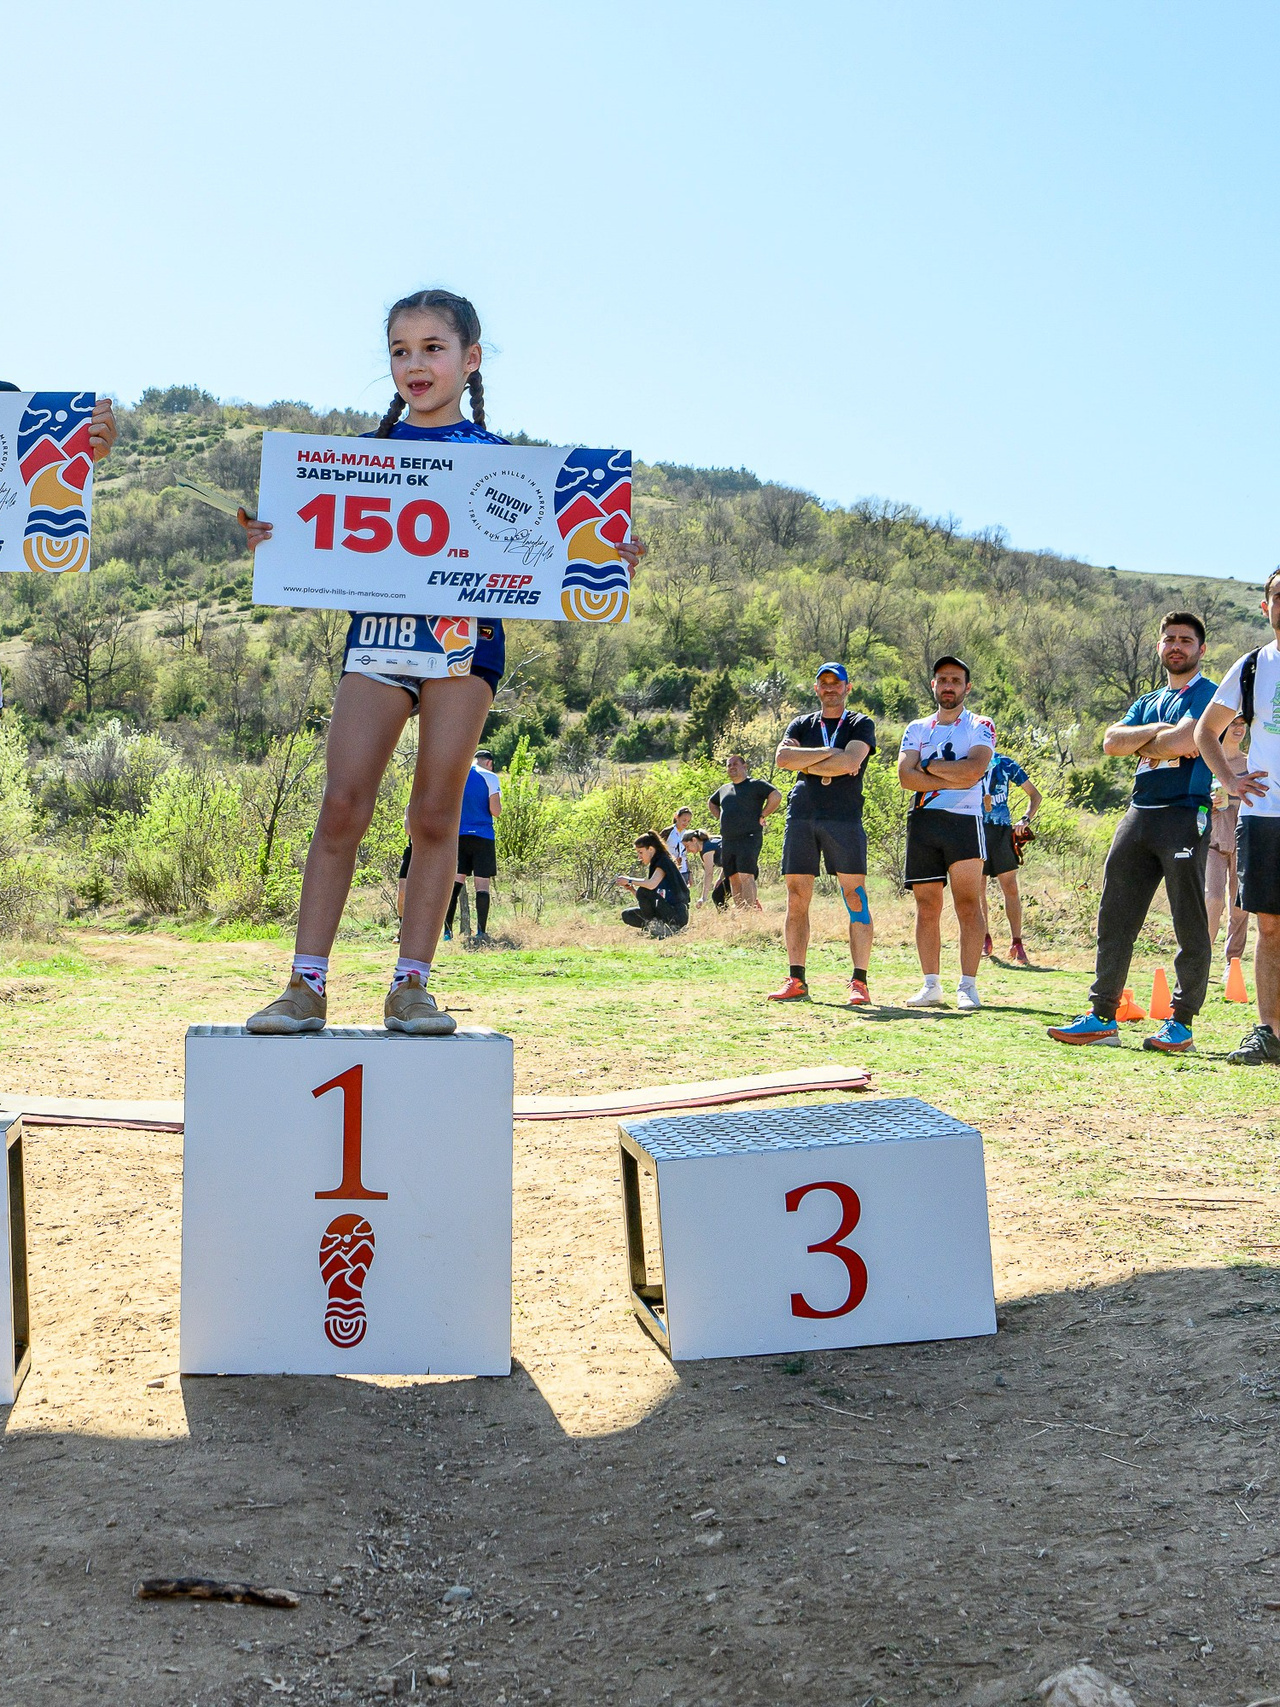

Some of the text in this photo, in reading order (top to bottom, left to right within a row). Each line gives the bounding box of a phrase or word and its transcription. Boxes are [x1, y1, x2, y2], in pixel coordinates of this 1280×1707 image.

[297, 449, 453, 471] НАЙ-МЛАД БЕГАЧ
[296, 467, 402, 485] ЗАВЪРШИЛ
[469, 470, 546, 527] PLOVDIV HILLS IN MARKOVO
[484, 486, 533, 515] PLOVDIV
[486, 502, 519, 524] HILLS
[296, 493, 451, 557] 150
[468, 508, 483, 531] TRAIL
[483, 530, 500, 541] RUN
[282, 585, 407, 599] www.plovdiv-hills-in-markovo.com
[427, 570, 533, 590] EVERY STEP
[457, 587, 542, 605] MATTERS
[358, 616, 417, 648] 0118
[311, 1063, 389, 1200] 1
[784, 1180, 869, 1319] 3
